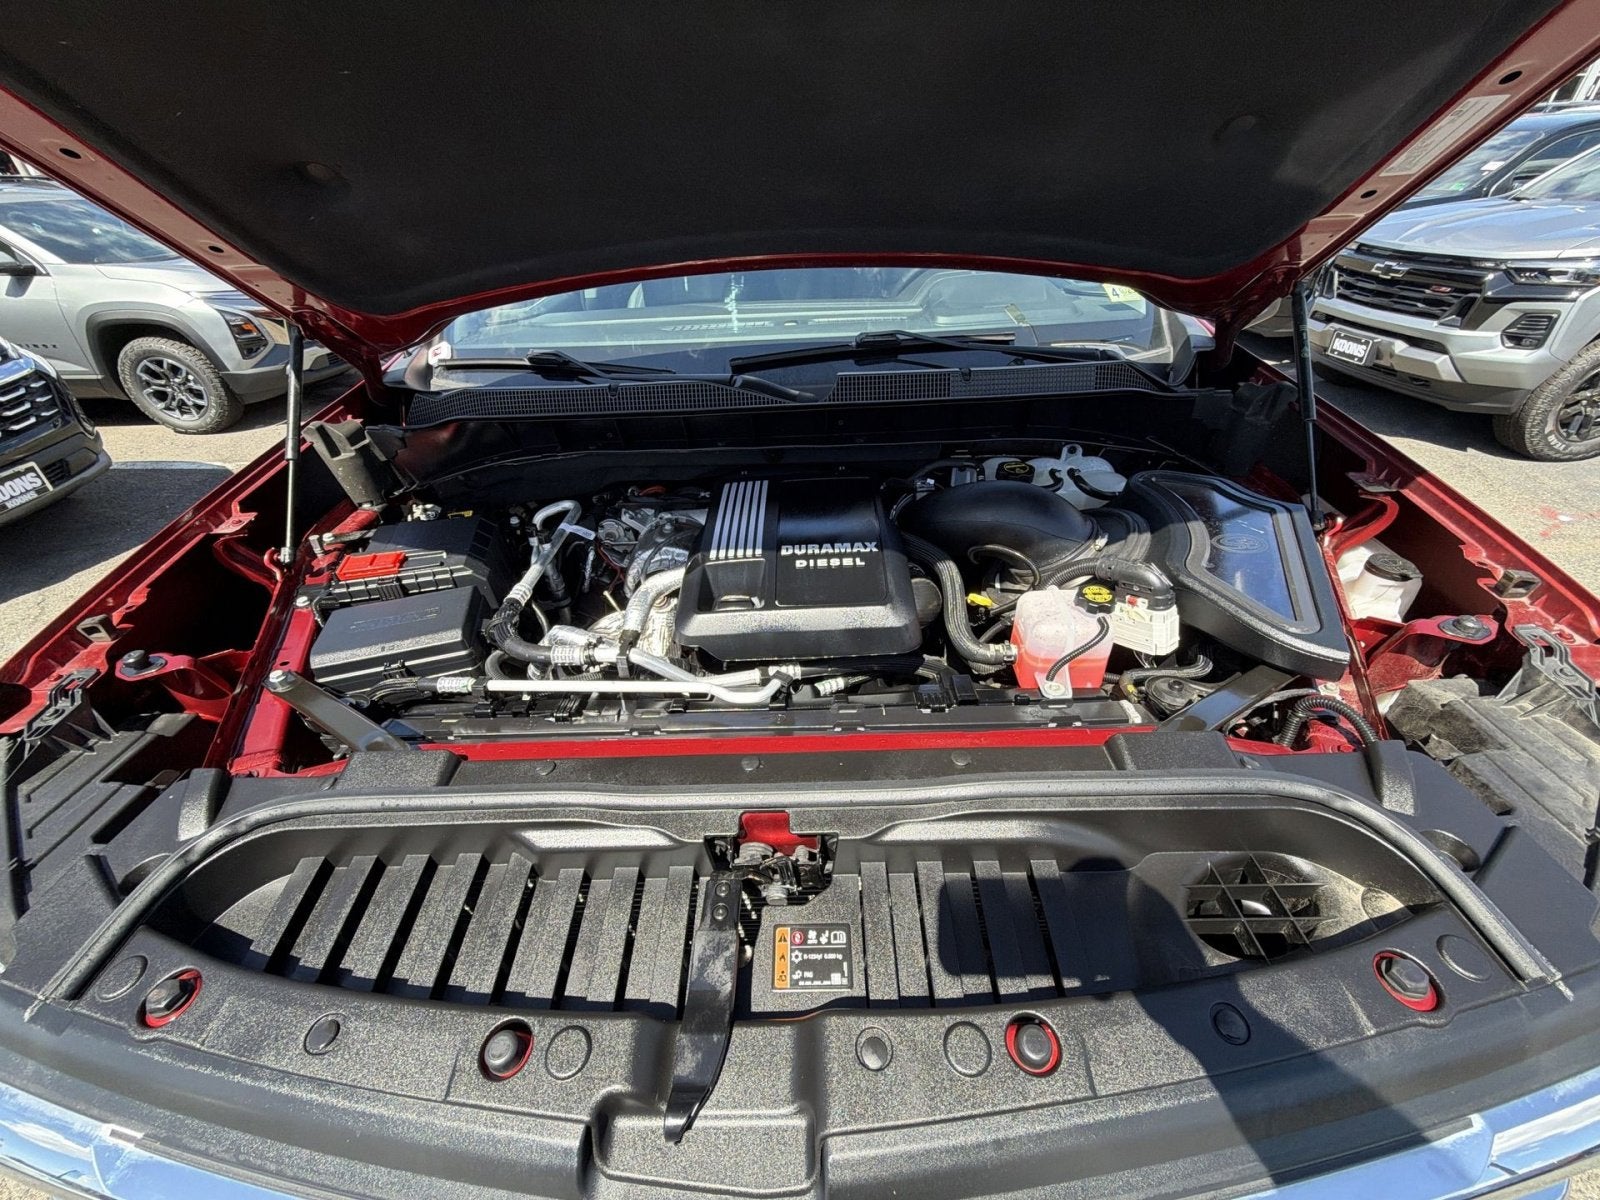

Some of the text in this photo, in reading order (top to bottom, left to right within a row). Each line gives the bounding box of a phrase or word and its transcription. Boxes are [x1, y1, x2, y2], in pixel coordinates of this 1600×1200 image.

[1332, 338, 1367, 357] KOONS
[781, 542, 879, 555] DURAMAX
[796, 557, 866, 569] DIESEL
